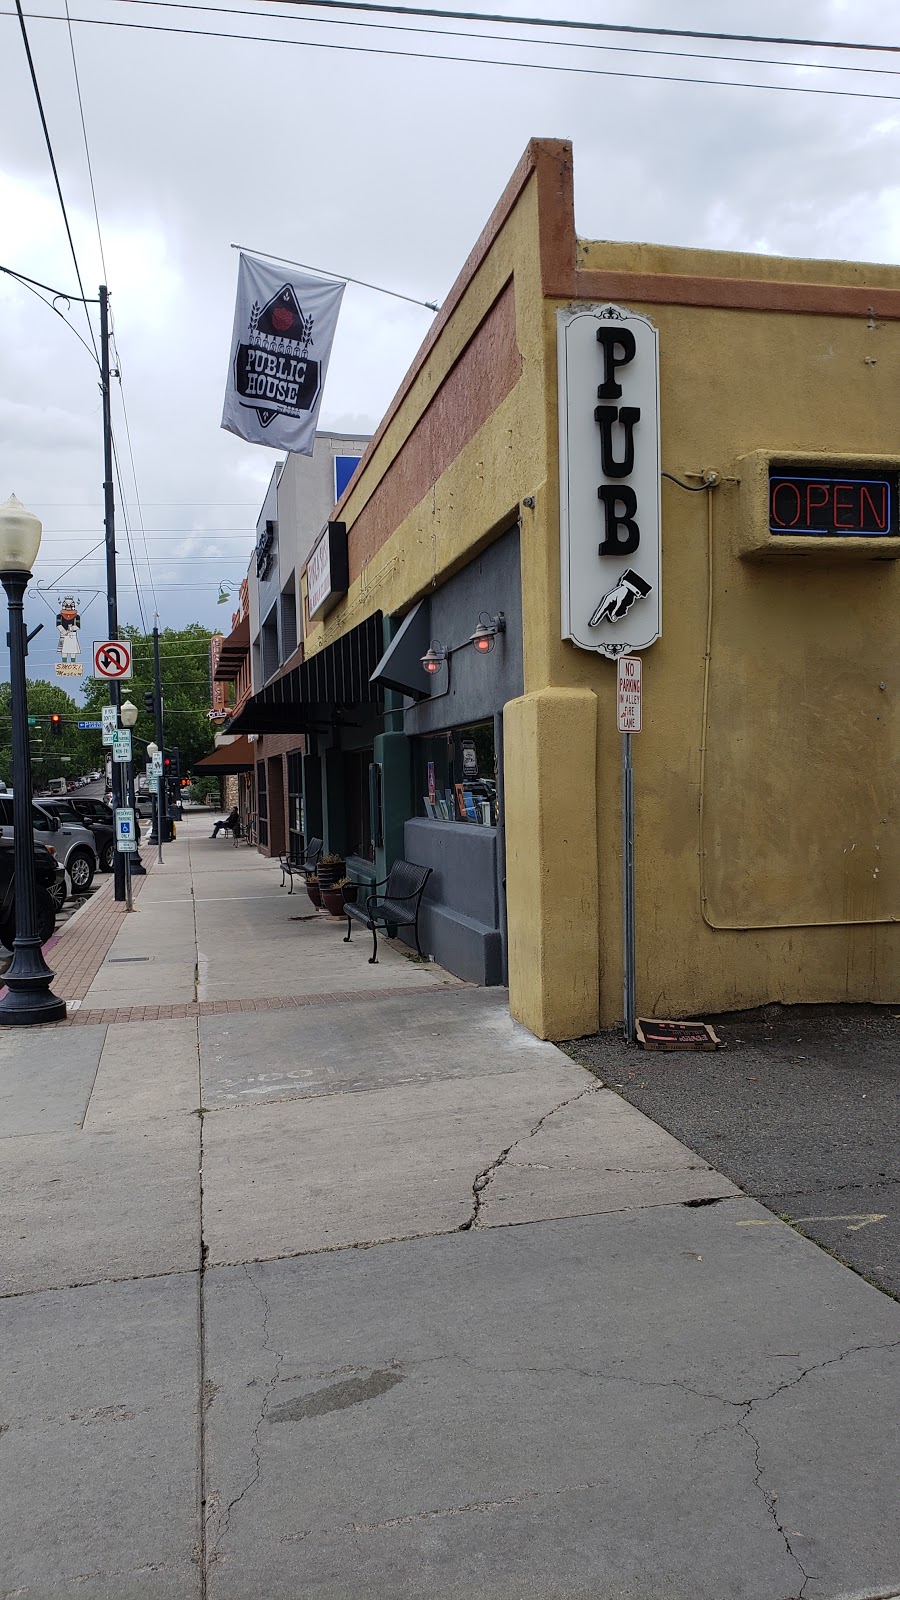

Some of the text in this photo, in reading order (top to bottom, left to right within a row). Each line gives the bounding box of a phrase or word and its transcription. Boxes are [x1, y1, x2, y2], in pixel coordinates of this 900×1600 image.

[245, 349, 307, 383] PUBLIC
[245, 373, 300, 405] HOUSE
[594, 326, 640, 557] PUB
[772, 482, 886, 529] OPEN
[625, 662, 635, 677] NO
[619, 678, 640, 693] PARKING
[625, 694, 640, 705] ALLEY
[624, 706, 635, 716] FIRE
[624, 717, 636, 728] LANE
[113, 731, 118, 741] 2
